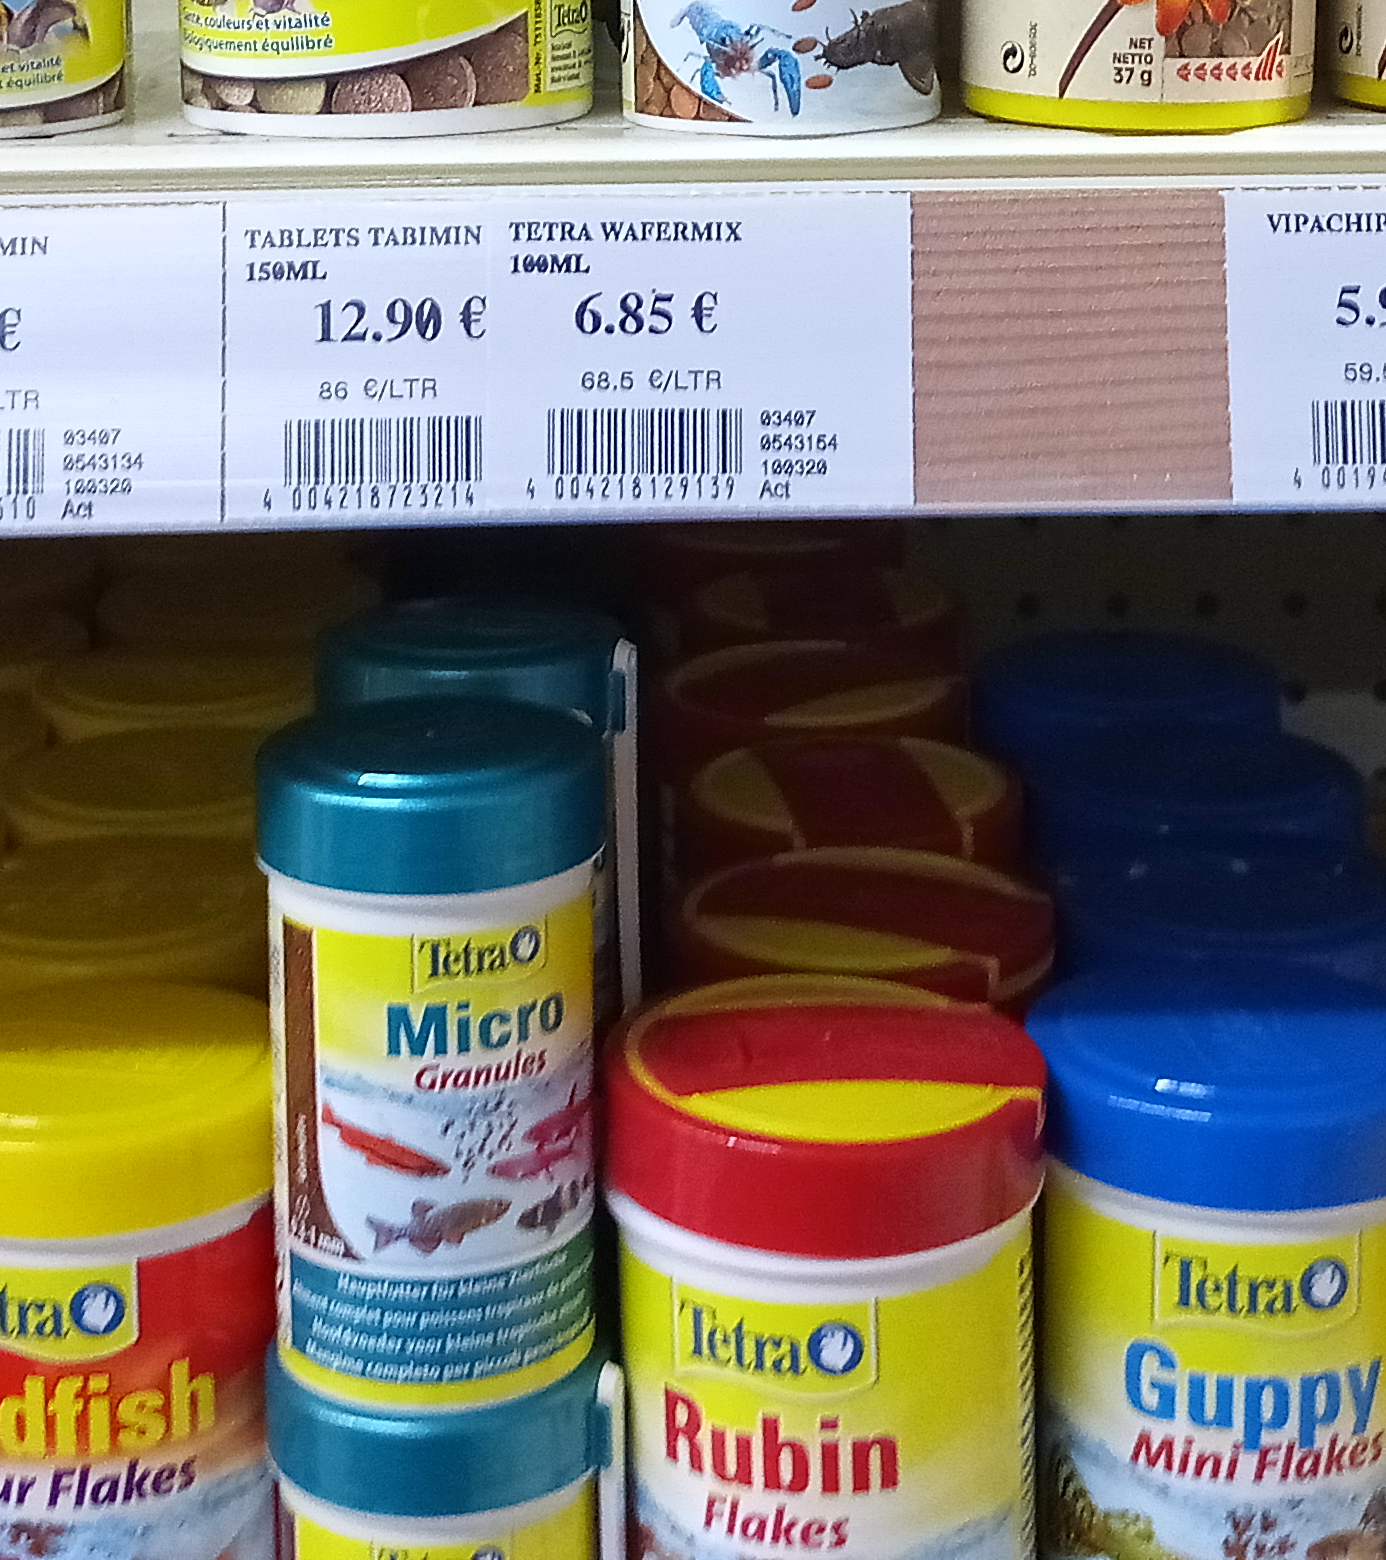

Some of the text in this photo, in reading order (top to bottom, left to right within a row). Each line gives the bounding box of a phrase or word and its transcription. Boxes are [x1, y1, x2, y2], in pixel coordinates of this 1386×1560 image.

[1128, 38, 1153, 50] NET
[1113, 52, 1153, 65] NETTO
[1113, 66, 1152, 86] 37 g
[244, 225, 483, 250] TABLETS TABIMIN
[509, 221, 743, 243] TETRA WAFERMIX
[245, 260, 328, 282] 150ML
[510, 253, 591, 275] 100ML
[314, 295, 488, 344] 12.90 €
[574, 290, 719, 335] 6.85 €
[318, 378, 439, 403] 86 €/LTR
[580, 369, 723, 394] 68.5 €/LTR
[760, 409, 816, 427] 03407
[63, 429, 122, 446] 03407
[63, 453, 144, 472] 0543134
[760, 459, 827, 476] 100320
[759, 479, 791, 500] Act
[418, 937, 510, 982] Tetra
[385, 992, 564, 1058] Micro
[414, 1049, 548, 1092] Granules
[1162, 1249, 1299, 1317] Tetra
[679, 1299, 809, 1376] Tetra
[1124, 1336, 1383, 1453] Guppy
[663, 1382, 899, 1496] Rubin
[1129, 1429, 1384, 1485] Mini Flakes
[46, 1455, 199, 1510] Flakes
[703, 1494, 850, 1550] Flakes
